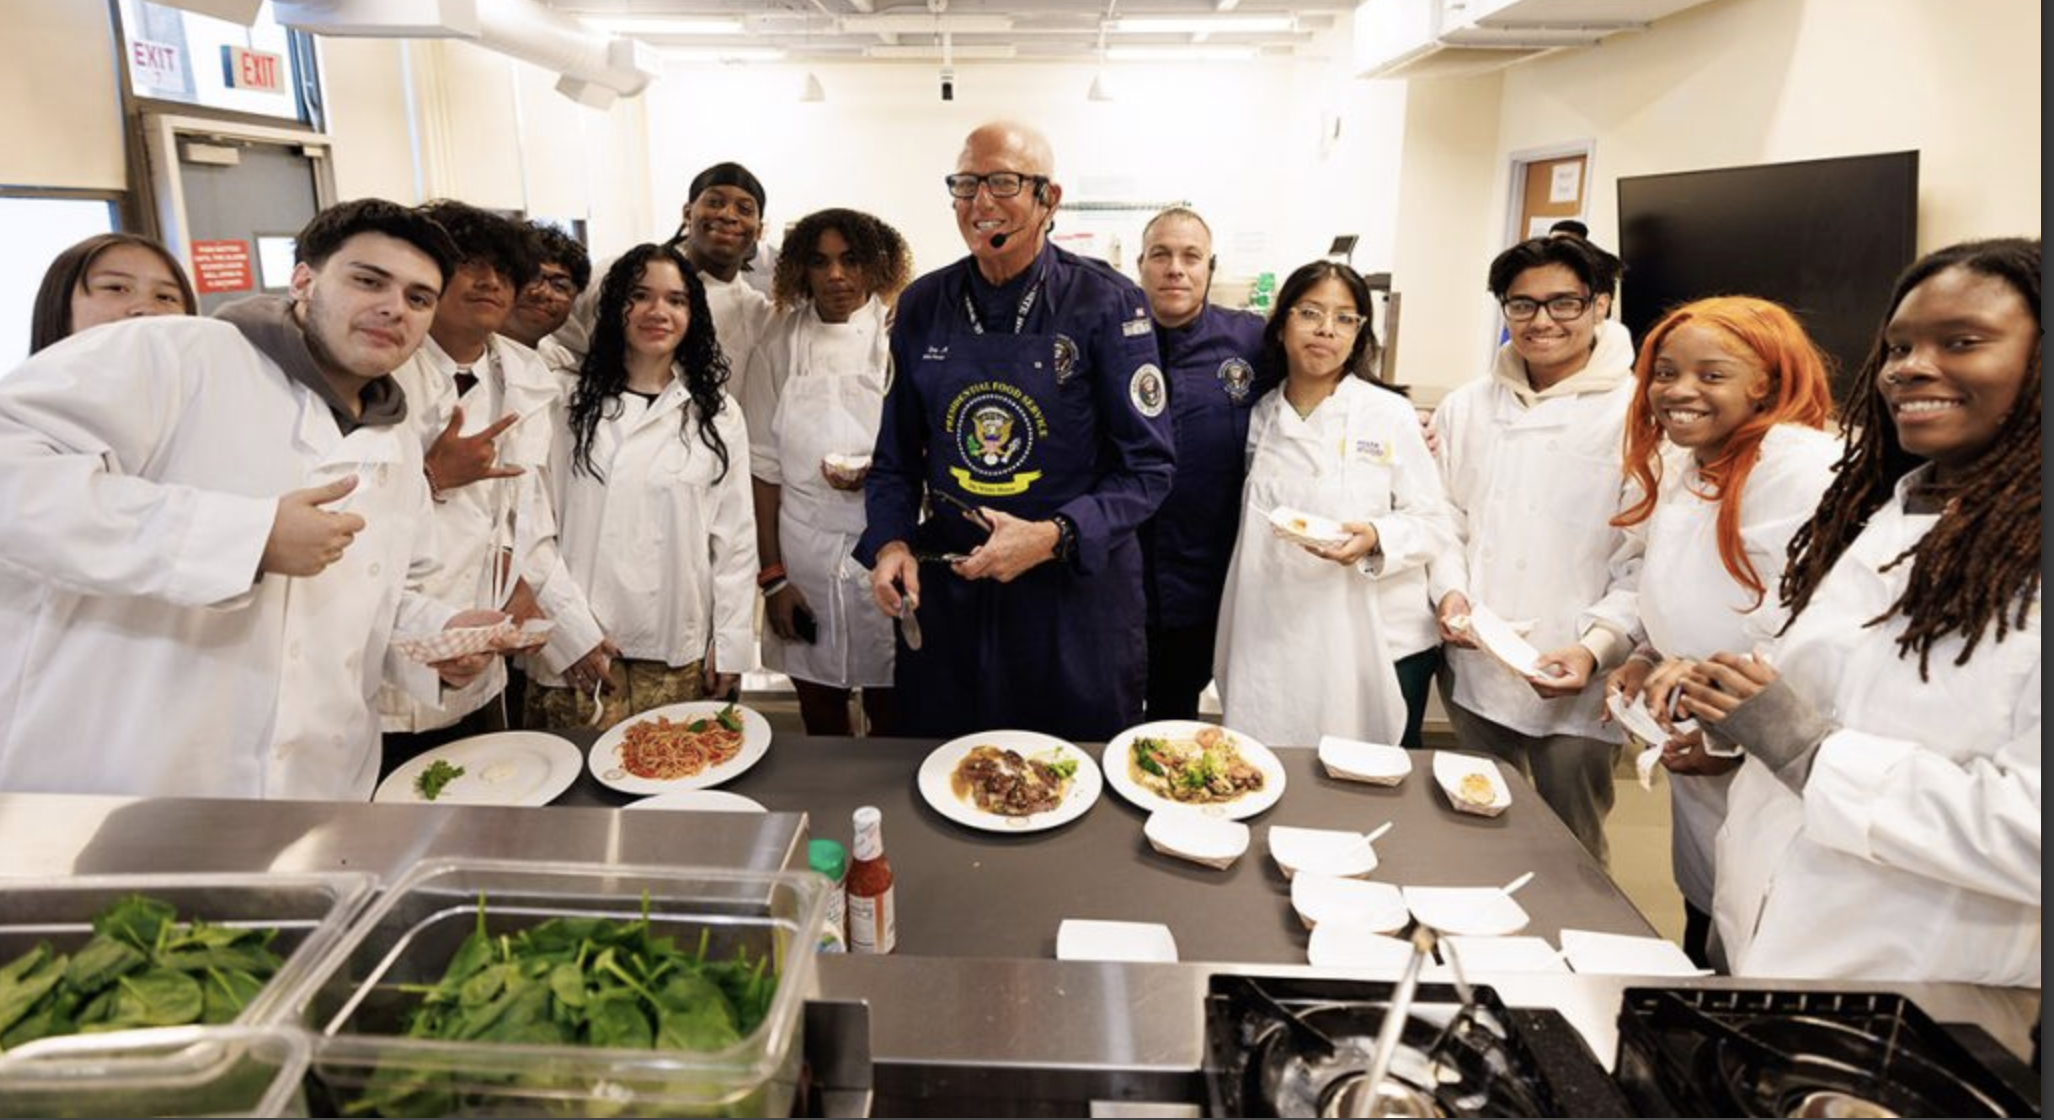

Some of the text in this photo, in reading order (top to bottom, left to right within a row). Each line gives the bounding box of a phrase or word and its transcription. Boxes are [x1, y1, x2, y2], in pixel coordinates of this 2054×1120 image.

[133, 41, 174, 72] EXIT
[241, 52, 275, 89] EXIT
[946, 381, 1048, 438] PRESIDENTIAL FOOD SERVICE
